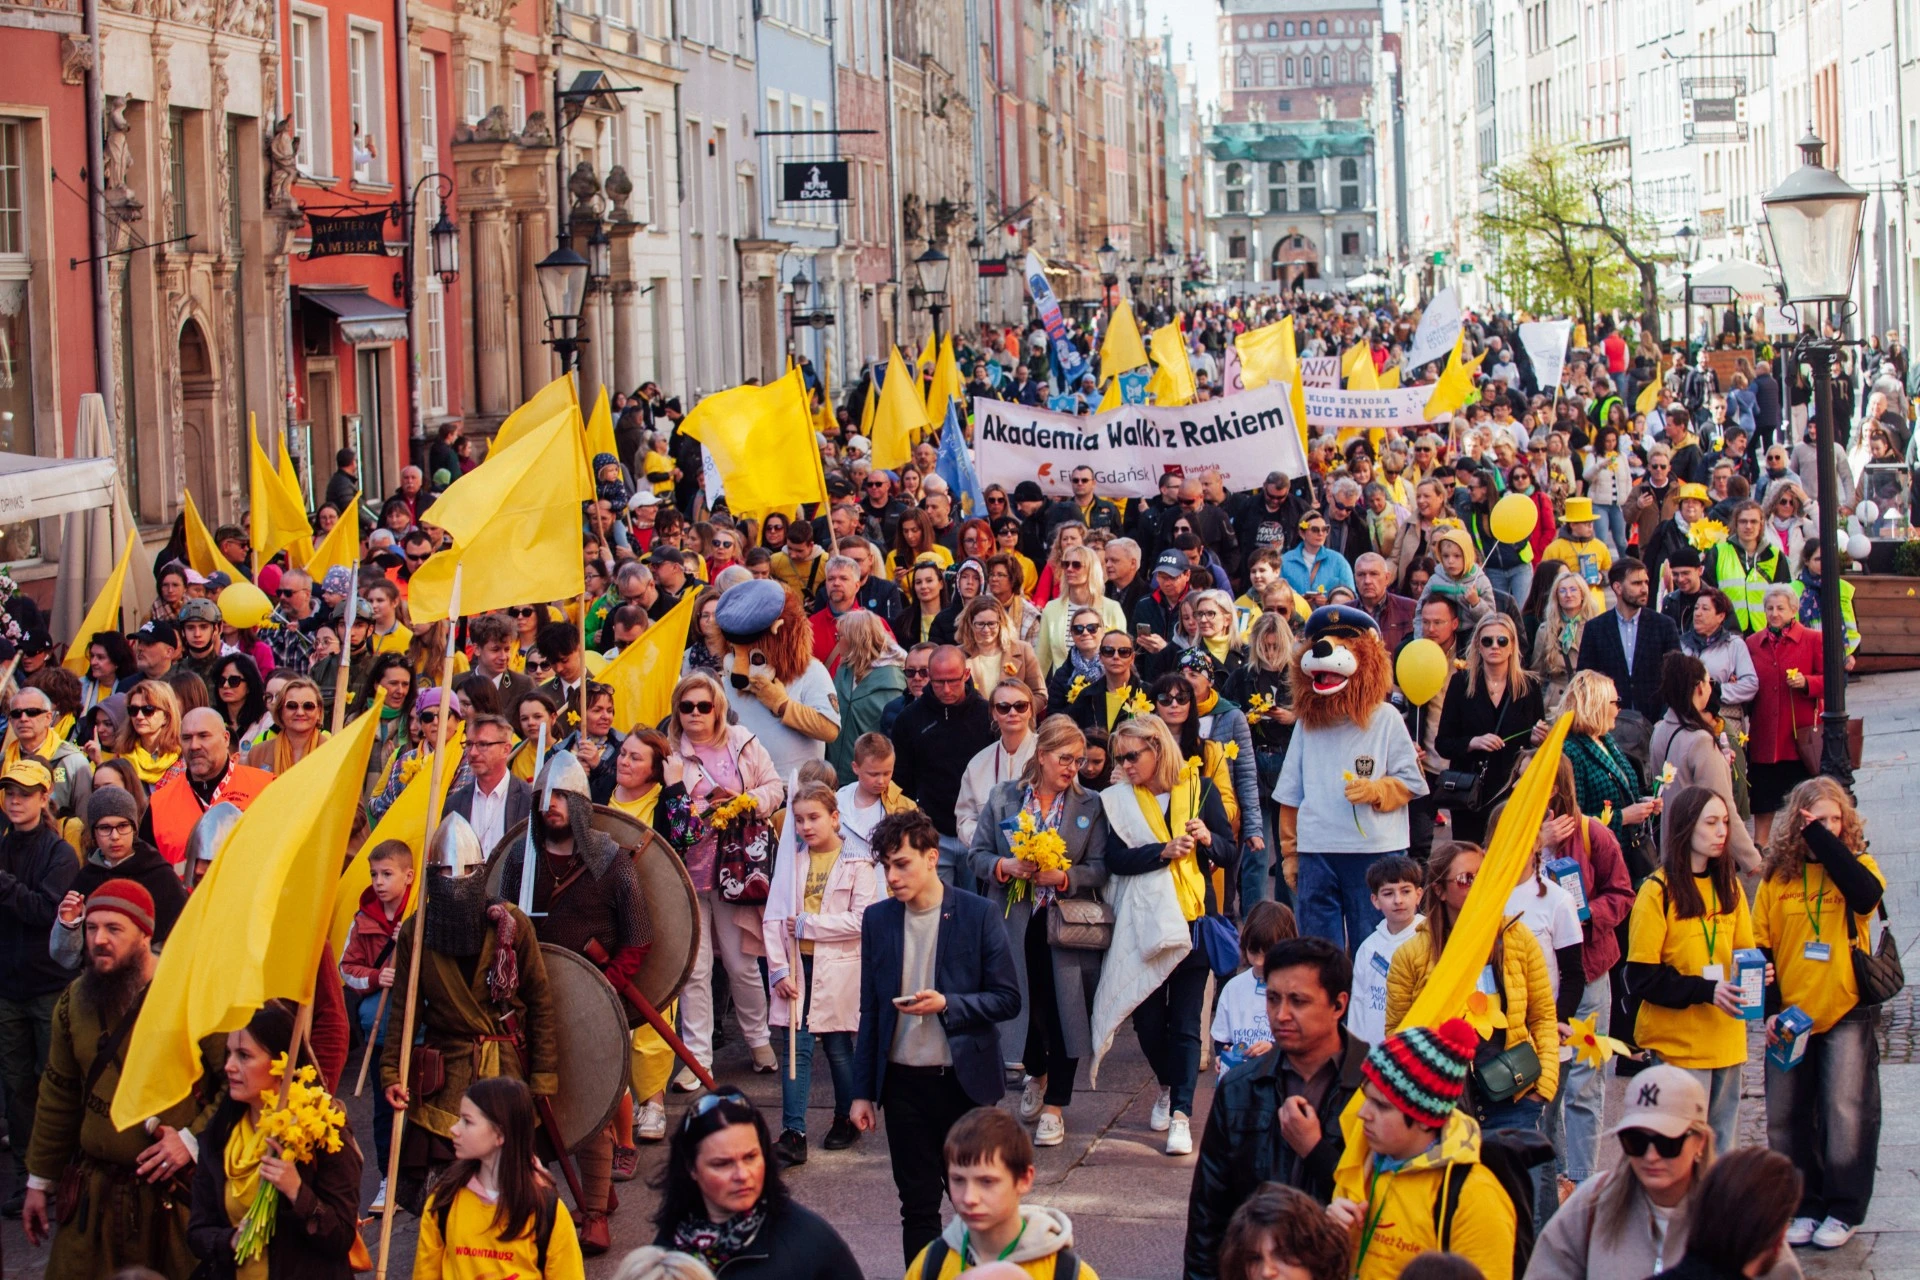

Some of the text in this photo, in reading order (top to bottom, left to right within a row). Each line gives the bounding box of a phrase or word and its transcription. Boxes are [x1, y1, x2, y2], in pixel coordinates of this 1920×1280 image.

[800, 190, 832, 199] BAR
[316, 240, 378, 254] AMBER
[1308, 394, 1391, 405] KLUB SENIORA
[982, 406, 1285, 451] Akademia Walki z Rakiem
[1095, 465, 1150, 484] Gdańsk
[1159, 555, 1177, 564] BOSS
